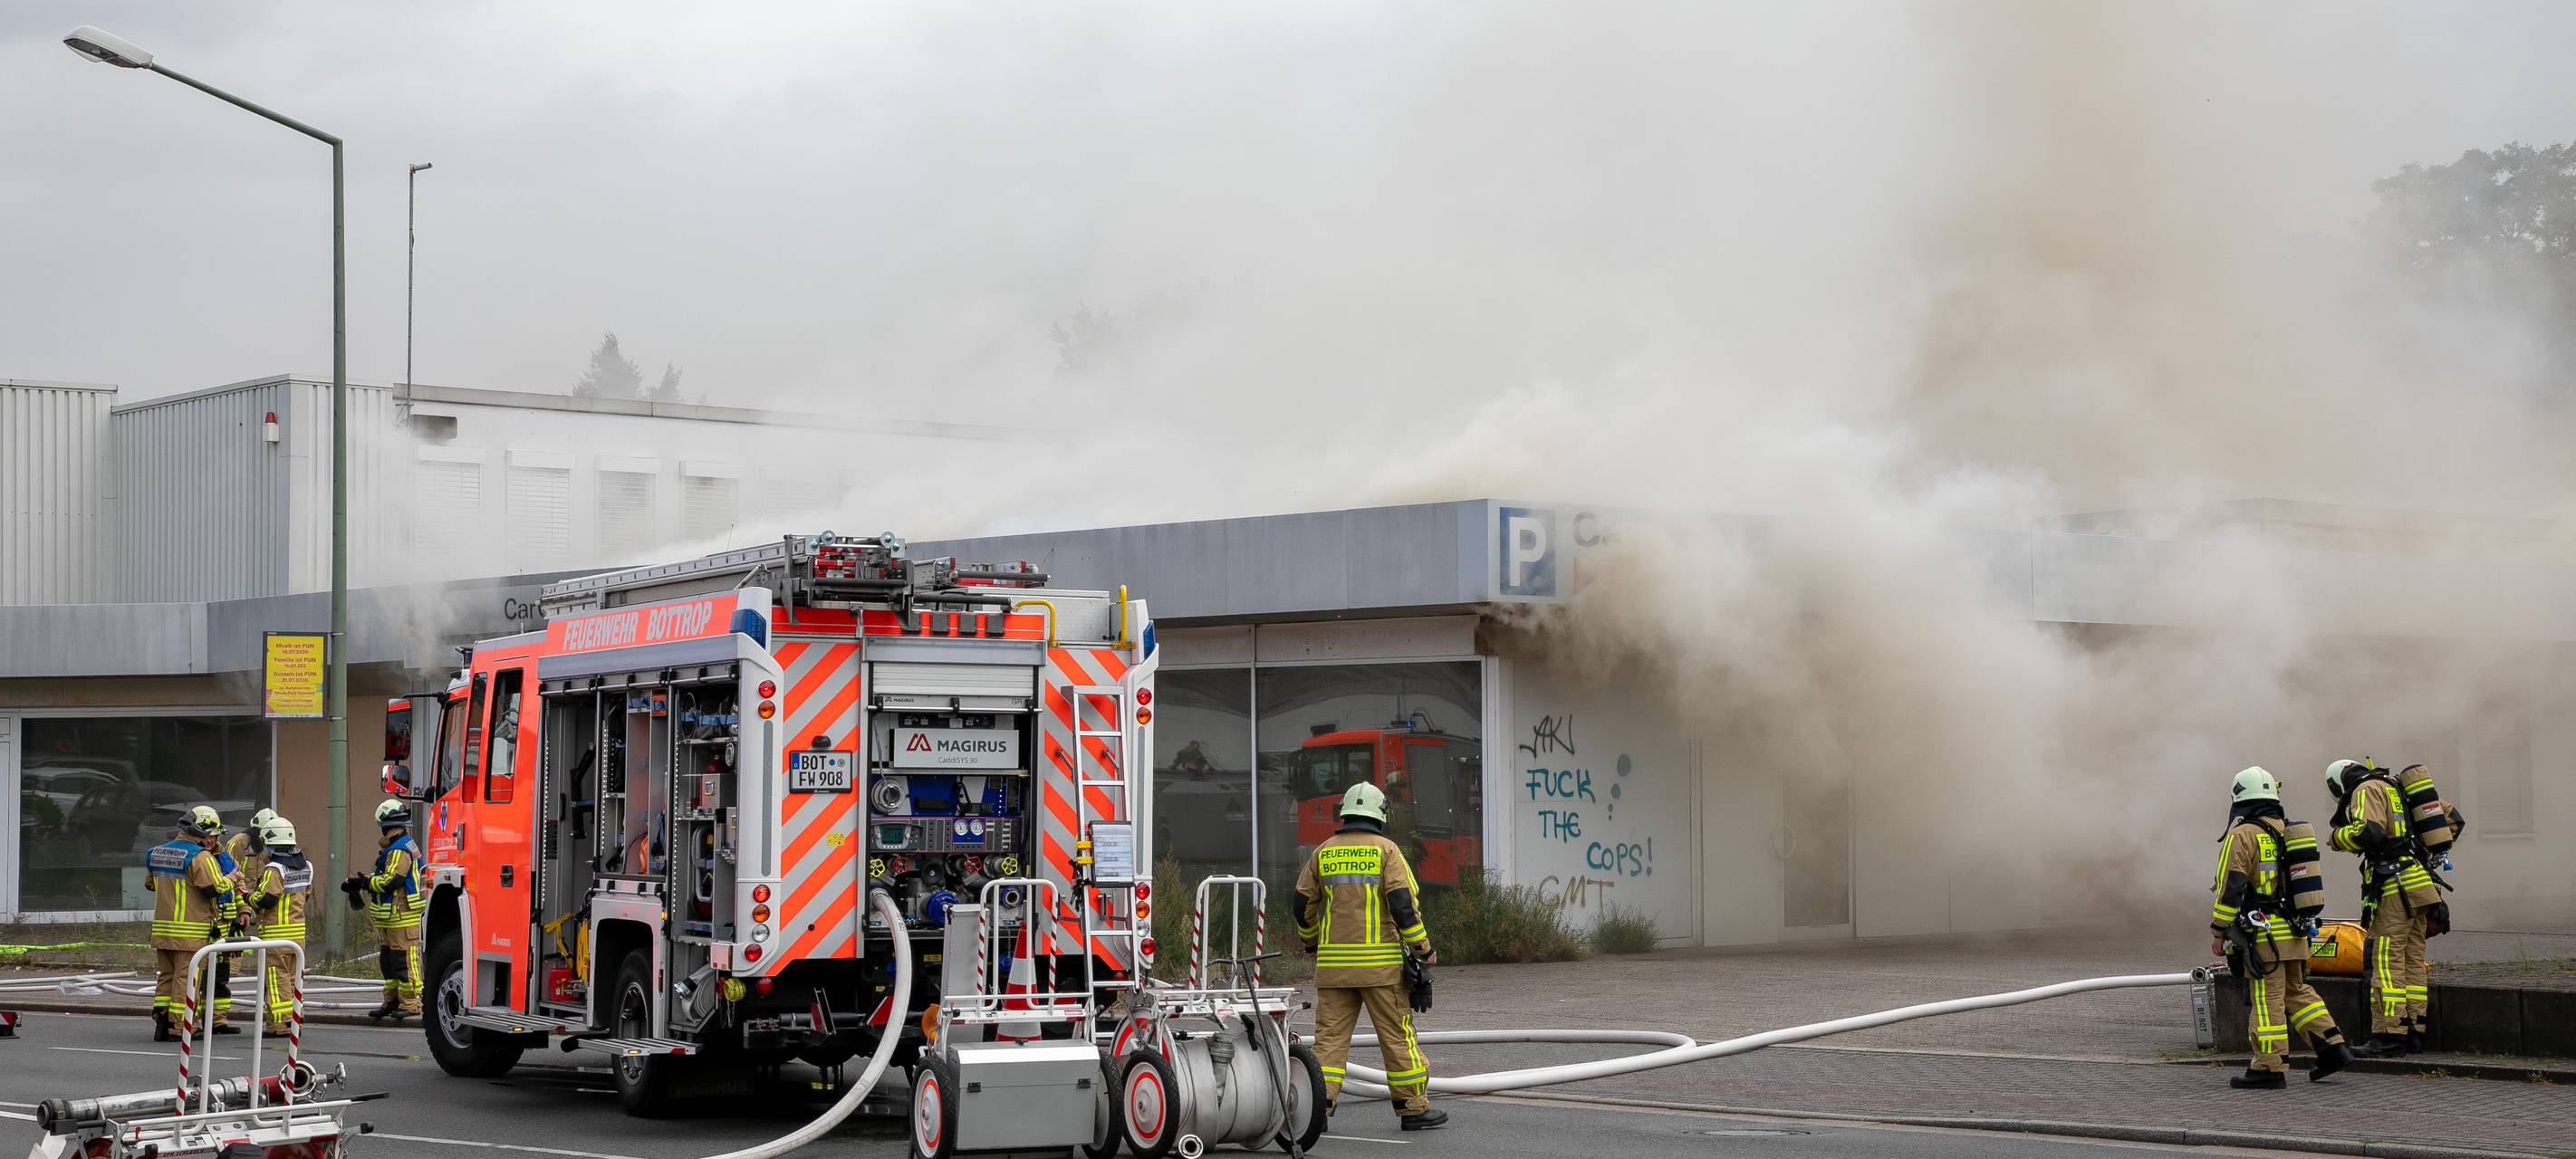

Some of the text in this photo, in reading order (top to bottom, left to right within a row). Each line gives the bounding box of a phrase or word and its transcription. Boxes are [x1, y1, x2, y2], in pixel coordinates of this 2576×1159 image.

[1508, 516, 1547, 587] P
[562, 601, 713, 652] FEUERWEHR BOTTROP
[937, 740, 1007, 752] MAGIRUS
[802, 755, 827, 770] BOT
[799, 771, 843, 787] FW 908
[1525, 768, 1596, 804] FUCK
[1538, 809, 1581, 844] THE
[153, 848, 187, 857] FEUERWEHR
[1321, 848, 1379, 859] FEUERWEHR
[1586, 837, 1653, 877] COPS!
[1322, 861, 1376, 873] BOTTROP
[2198, 1018, 2207, 1032] BOT
